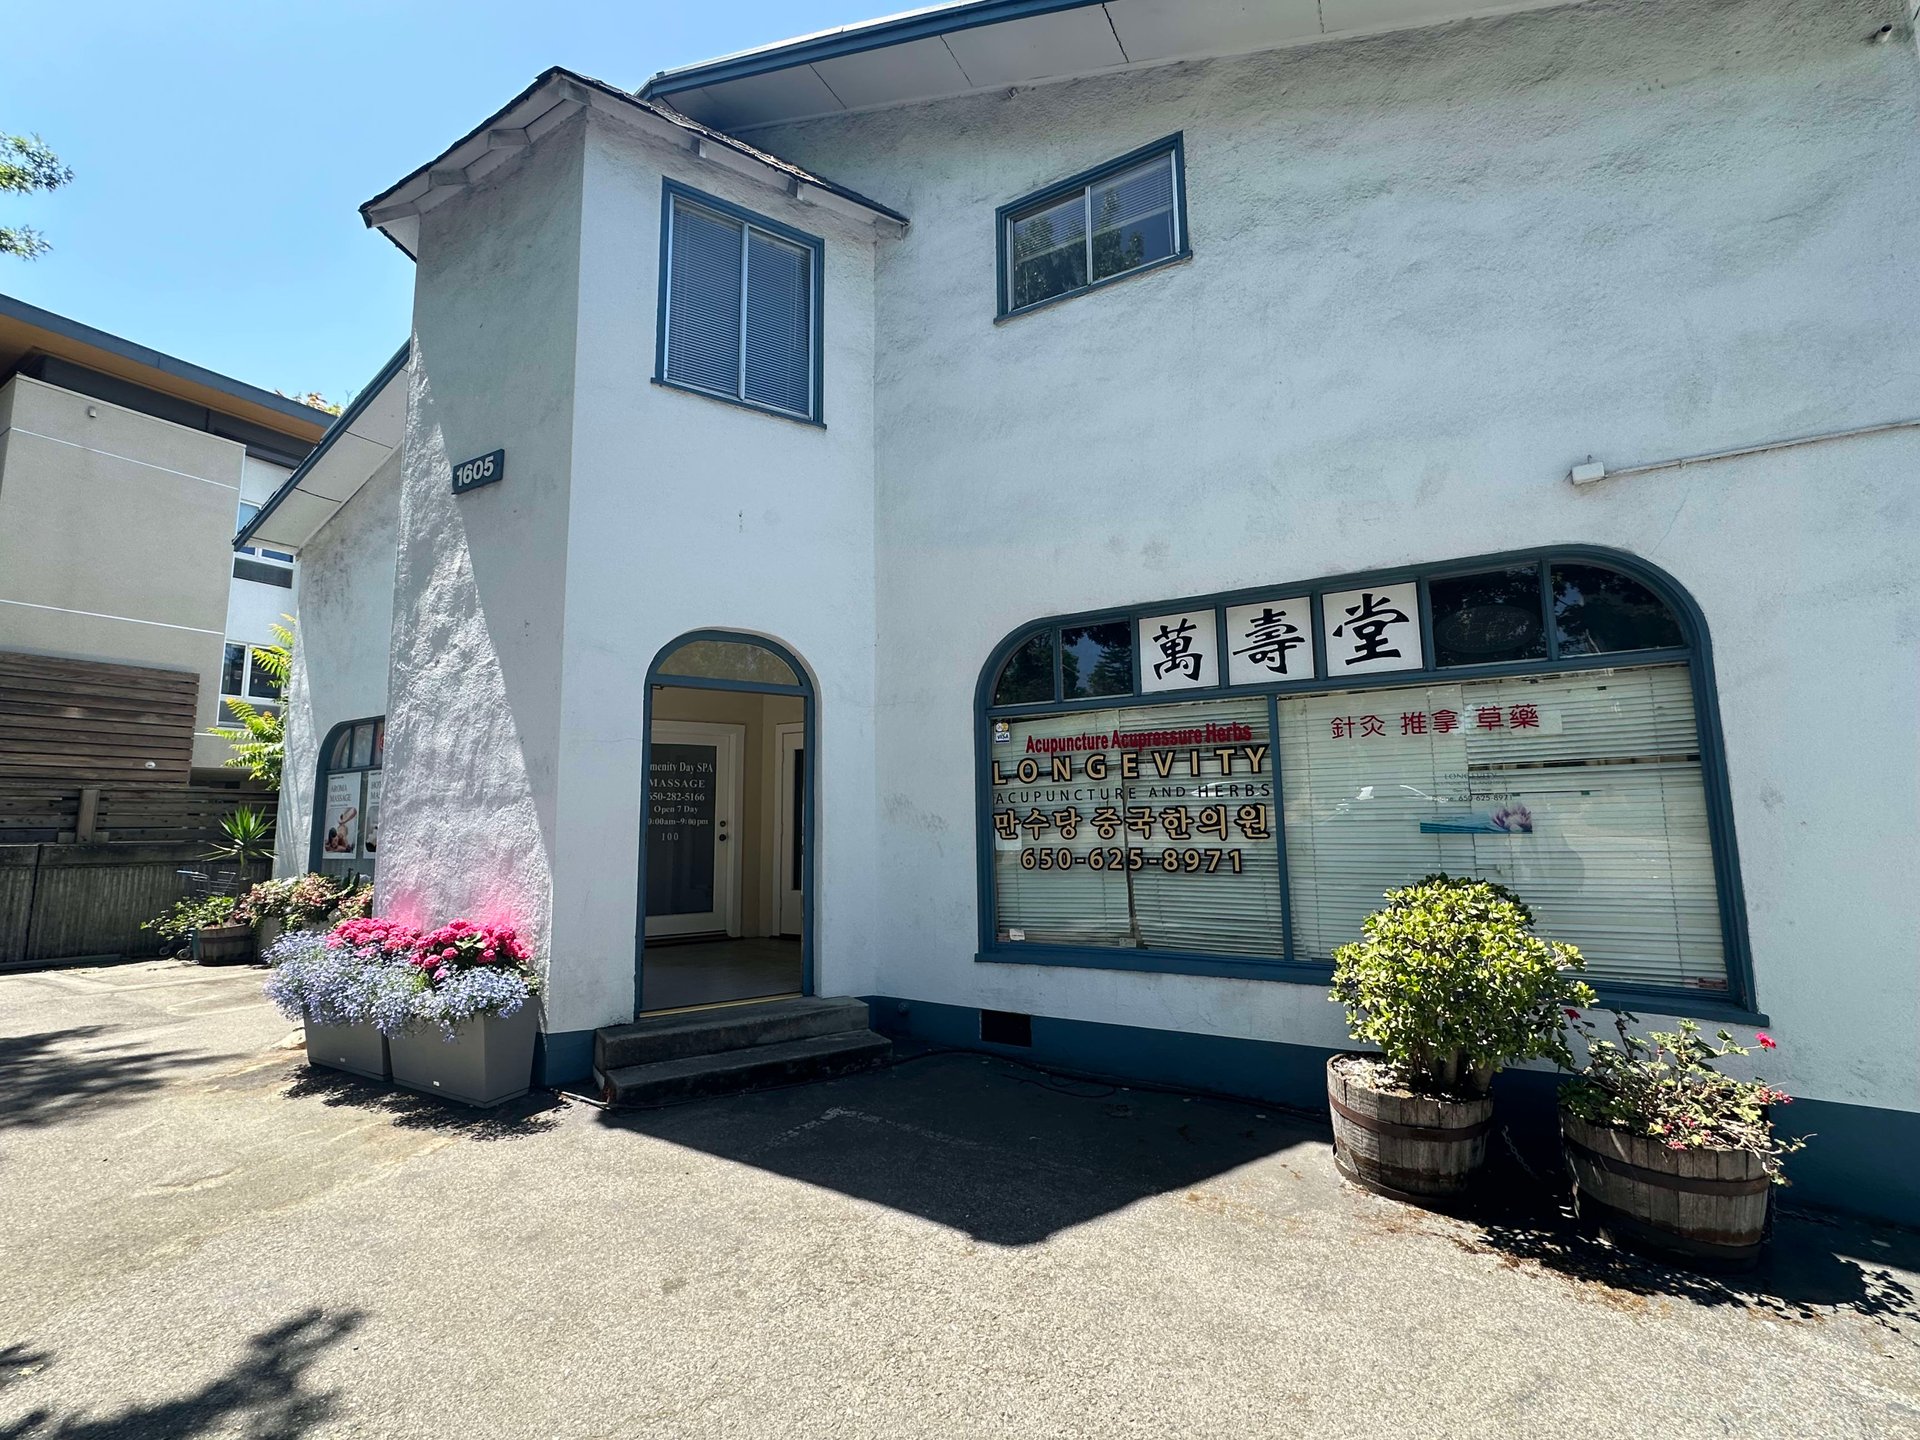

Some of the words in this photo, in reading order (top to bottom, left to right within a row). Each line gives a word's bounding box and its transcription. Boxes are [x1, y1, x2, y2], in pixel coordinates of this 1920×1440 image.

[456, 456, 494, 487] 1605
[1331, 714, 1386, 740] 針灸
[1400, 709, 1460, 736] 推拿
[1475, 703, 1540, 731] 草藥
[1025, 732, 1108, 754] Acupuncture
[1111, 725, 1203, 751] Acupressure
[1205, 722, 1252, 744] Herbs
[649, 761, 677, 774] menity
[679, 761, 695, 775] Day
[697, 762, 714, 773] SPA
[991, 743, 1270, 786] LONGEVITY
[649, 779, 706, 788] MASSAGE
[995, 787, 1137, 805] ACUPUNCTURE
[1149, 786, 1186, 798] AND
[1198, 783, 1271, 797] HERBS
[653, 805, 675, 814] Open
[683, 806, 698, 815] Day
[661, 832, 679, 841] 100
[1020, 847, 1242, 874] 650-625-8971
